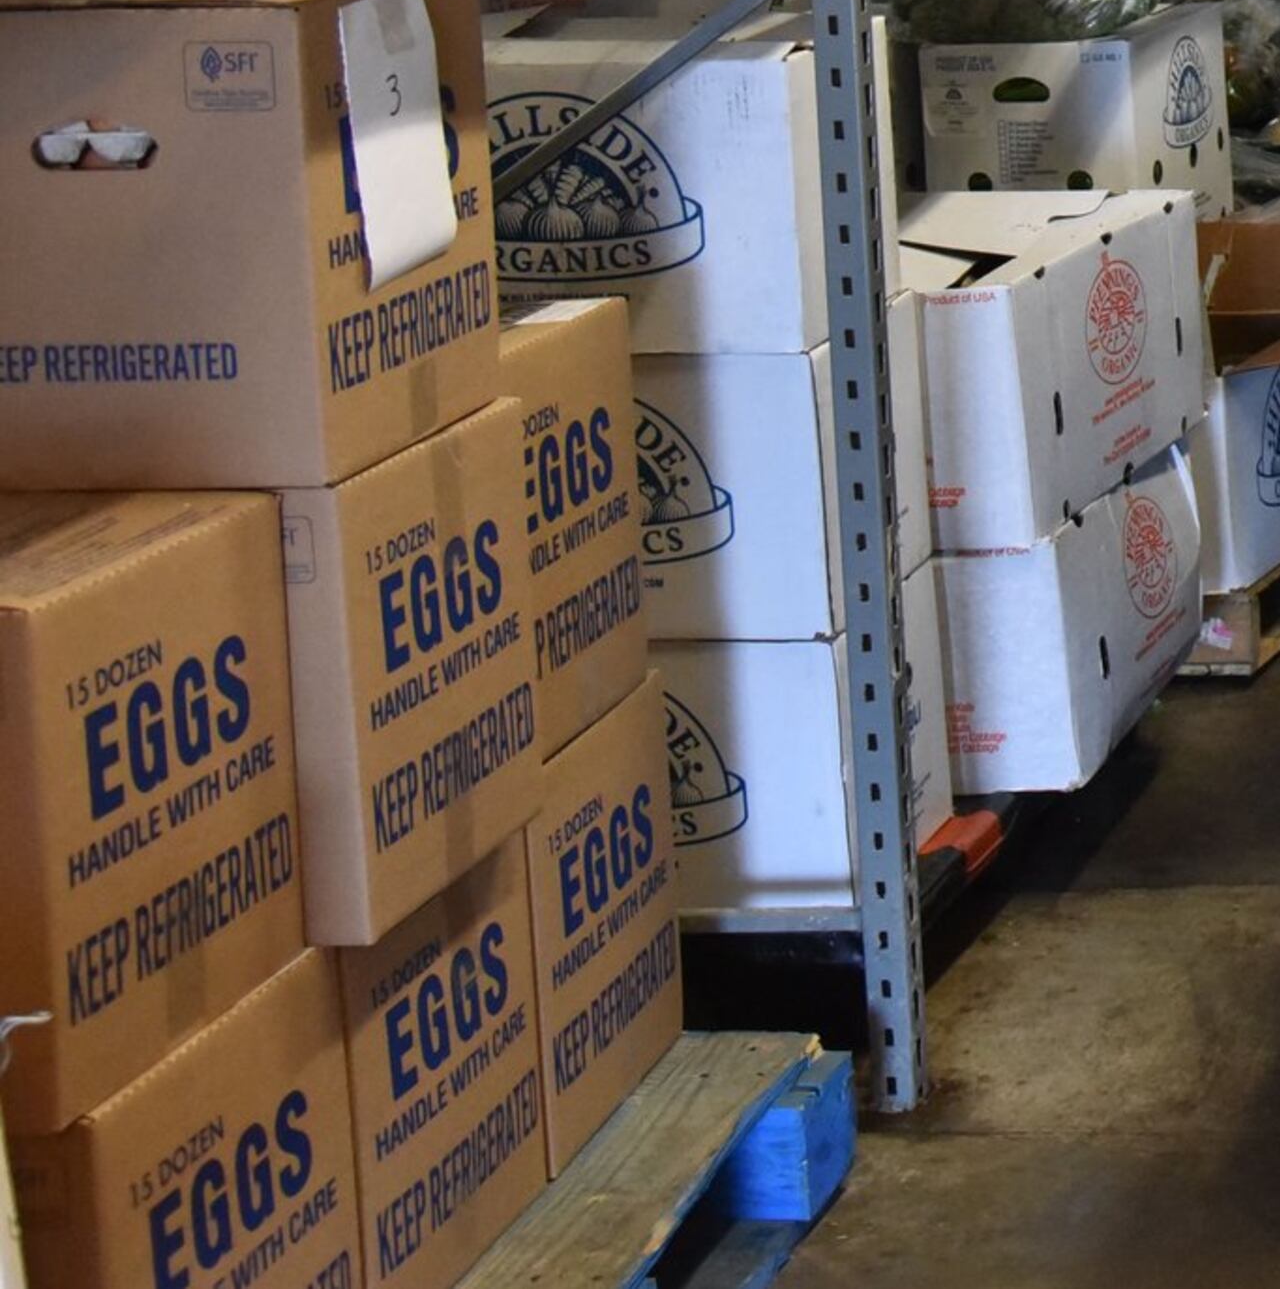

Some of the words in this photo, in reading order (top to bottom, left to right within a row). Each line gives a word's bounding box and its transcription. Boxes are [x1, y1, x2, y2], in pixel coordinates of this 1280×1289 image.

[386, 75, 402, 116] 3
[44, 343, 238, 382] REFRIGERATED
[328, 309, 374, 394] KEEP
[377, 260, 491, 373] REFRIGERATED
[925, 292, 960, 306] Product
[961, 293, 971, 304] of
[973, 292, 996, 303] USA
[379, 520, 501, 674] EGGS
[387, 518, 435, 559] DOZEN
[85, 635, 251, 821] EGGS
[95, 640, 163, 697] DOZEN
[371, 664, 438, 731] HANDLE
[441, 641, 481, 687] WITH
[485, 612, 521, 659] CARE
[68, 804, 162, 889] HANDLE
[165, 769, 221, 828] WITH
[226, 735, 275, 792] CARE
[373, 761, 417, 854] KEEP
[421, 682, 534, 821] REFRIGERATED
[66, 917, 131, 1028] KEEP
[135, 813, 293, 982] REFRIGERATED
[559, 783, 653, 938] EGGS
[385, 922, 508, 1101] EGGS
[552, 924, 605, 991] HANDLE
[552, 1009, 589, 1096] KEEP
[590, 919, 677, 1058] REFRIGERATED
[158, 1114, 224, 1186] DOZEN
[375, 1079, 448, 1162] HANDLE
[451, 1039, 490, 1097] WITH
[149, 1089, 312, 1289] EGGS
[289, 1177, 338, 1244] CARE
[376, 1178, 425, 1280] KEEP
[430, 1068, 538, 1234] REFRIGERATED
